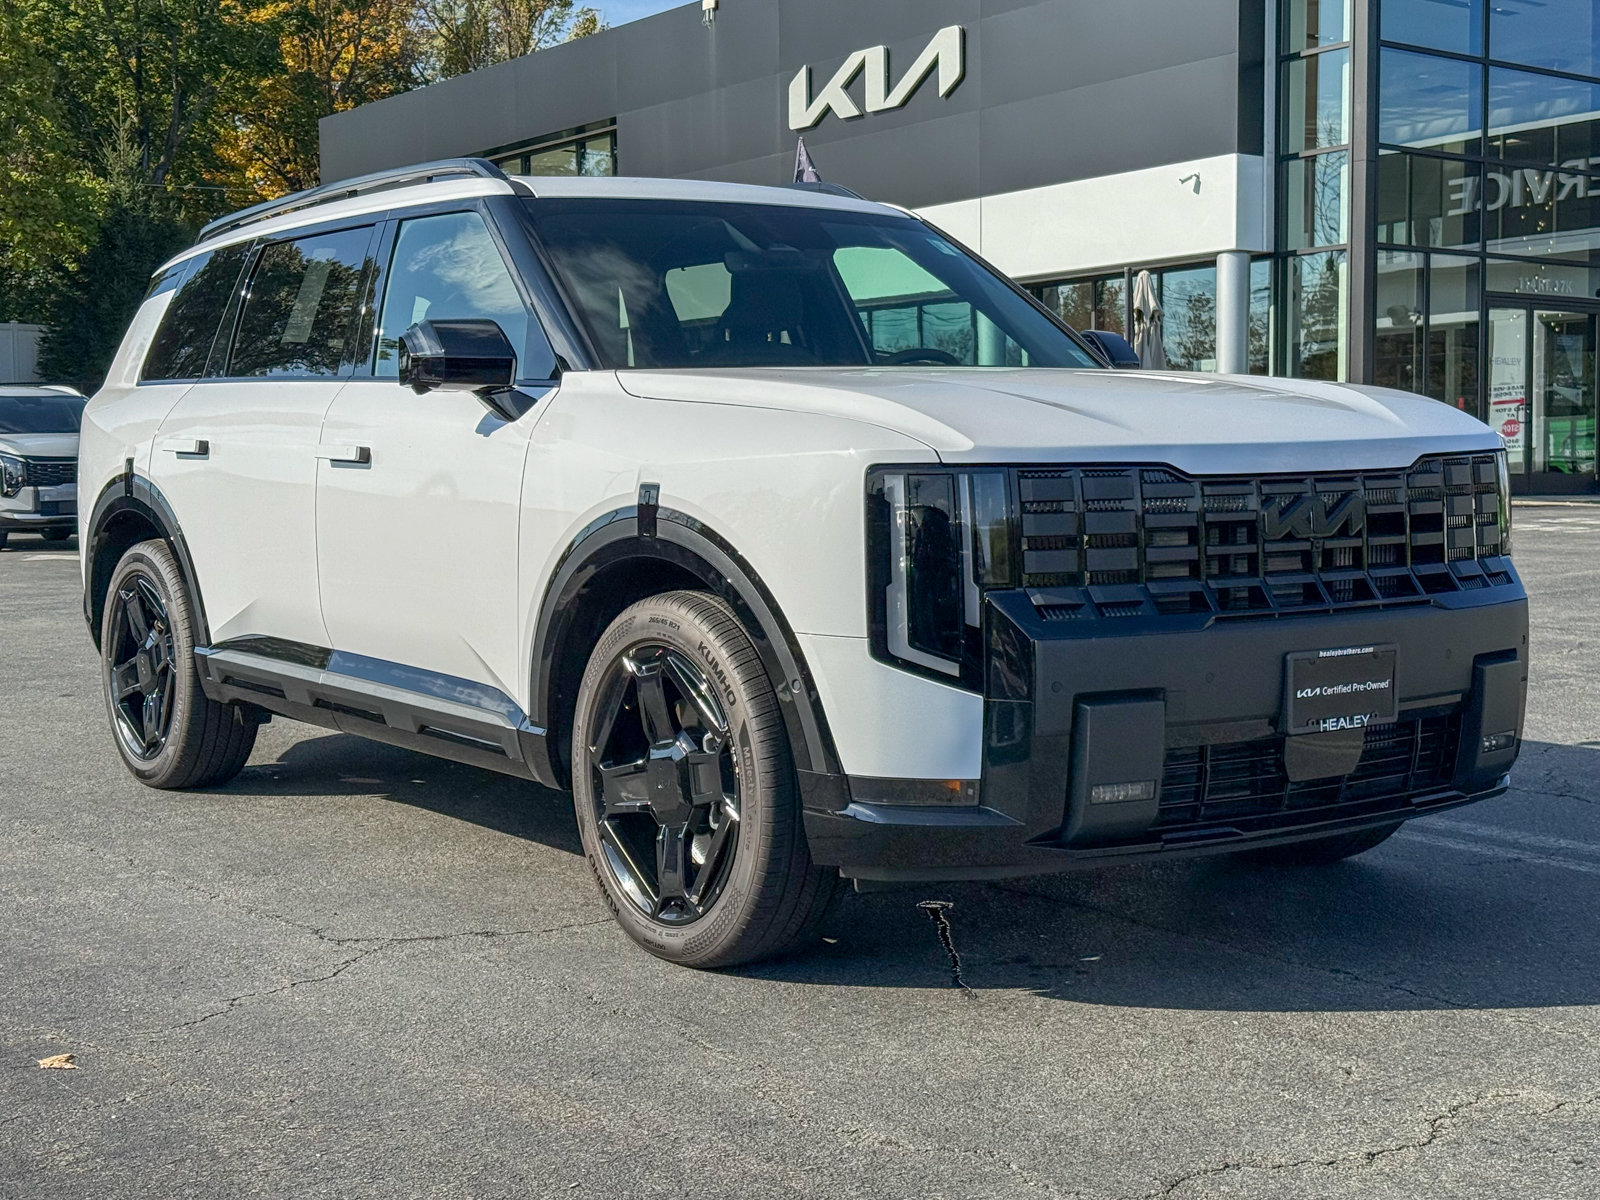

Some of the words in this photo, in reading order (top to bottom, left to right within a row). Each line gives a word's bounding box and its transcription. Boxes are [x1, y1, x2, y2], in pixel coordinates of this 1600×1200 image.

[789, 25, 964, 130] KIA
[1319, 647, 1374, 658] healeybrothers.com
[697, 640, 737, 707] KUMHO
[1296, 687, 1321, 698] KIA
[1322, 683, 1352, 696] Certified
[1320, 714, 1370, 732] HEALEY
